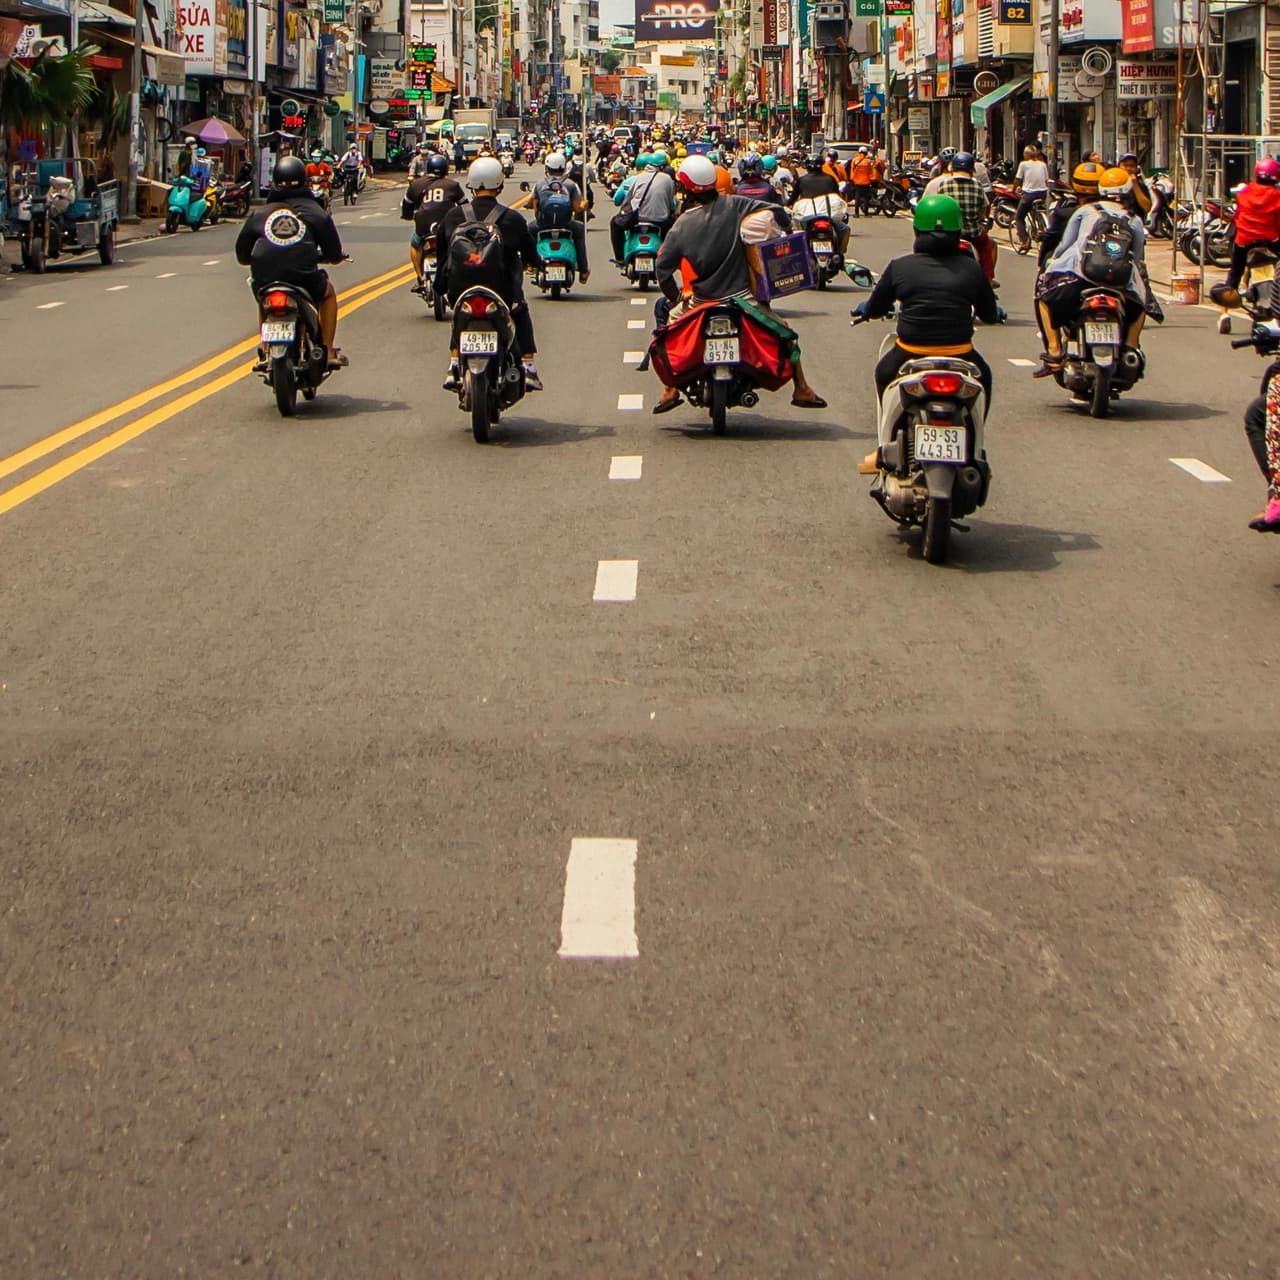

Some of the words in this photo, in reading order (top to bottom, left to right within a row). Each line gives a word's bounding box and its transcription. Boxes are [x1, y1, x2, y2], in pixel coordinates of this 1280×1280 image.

[179, 1, 211, 26] SỬA
[325, 10, 343, 20] SINH
[654, 4, 707, 29] PRO
[1007, 8, 1025, 19] 82
[184, 34, 205, 53] XE
[923, 429, 958, 443] 59-S3
[919, 444, 962, 460] 443.51
